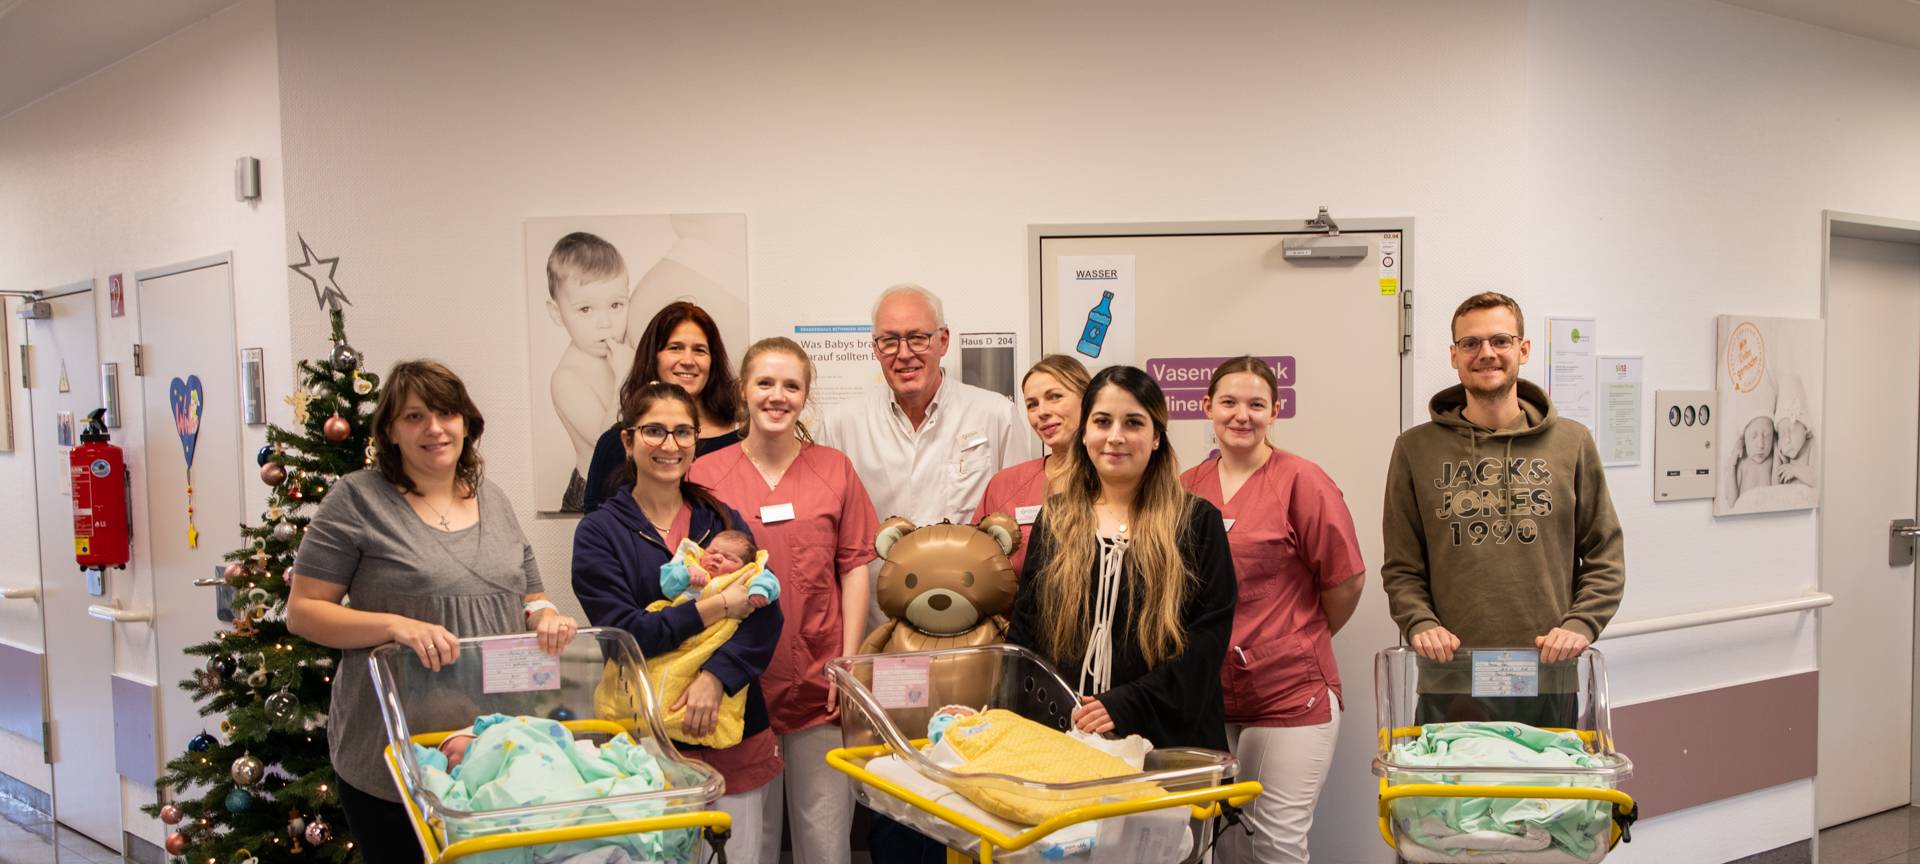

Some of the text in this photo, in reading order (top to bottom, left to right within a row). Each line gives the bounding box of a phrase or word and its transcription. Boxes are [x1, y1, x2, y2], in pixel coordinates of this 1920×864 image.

[1076, 269, 1118, 279] WASSER
[801, 340, 822, 349] Was
[825, 340, 855, 351] Babys
[961, 338, 983, 346] Haus
[998, 337, 1013, 345] 204
[835, 352, 869, 361] sollten
[1436, 488, 1552, 519] JONES
[1450, 519, 1538, 546] 1990
